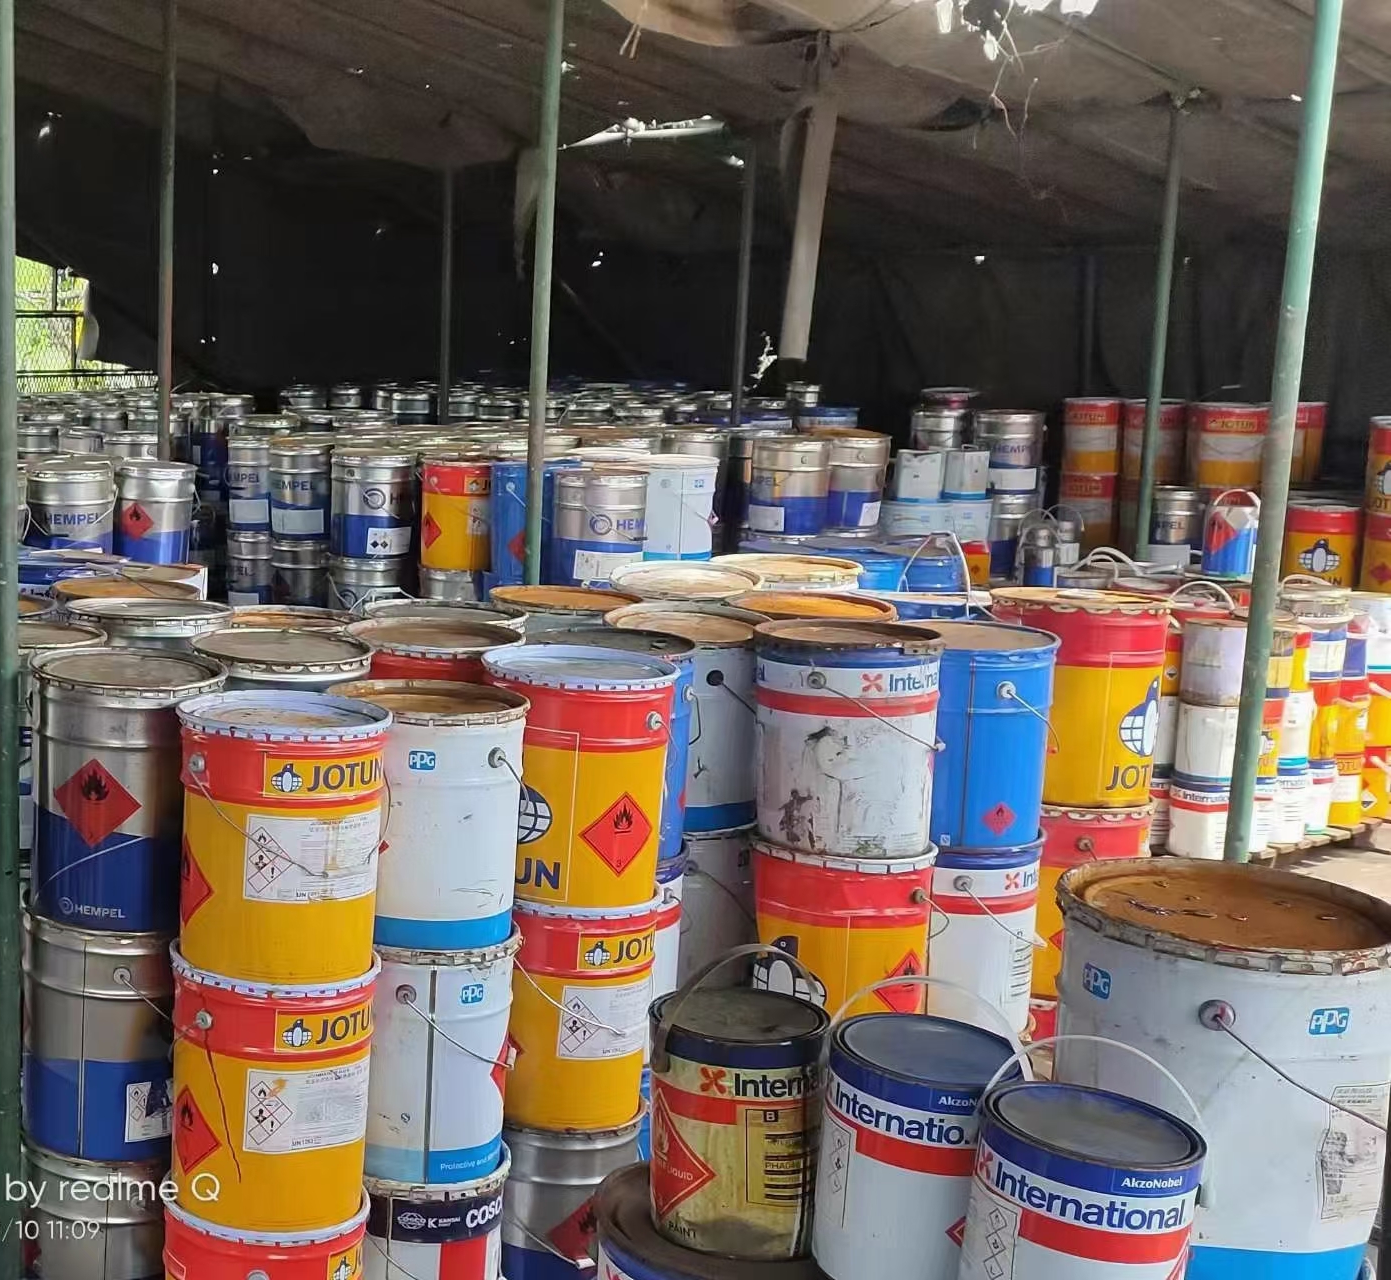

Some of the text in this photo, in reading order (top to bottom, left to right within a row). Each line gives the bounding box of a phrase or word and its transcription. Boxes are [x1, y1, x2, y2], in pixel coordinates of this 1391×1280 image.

[409, 751, 435, 770] PPG
[74, 904, 126, 919] HEMPEL
[462, 985, 484, 1004] PPG
[1311, 1008, 1349, 1033] PPG
[766, 1111, 775, 1121] B
[836, 1082, 970, 1146] Internatio
[1120, 1174, 1183, 1188] AkzoNobel
[994, 1159, 1187, 1231] International
[427, 1217, 438, 1229] K
